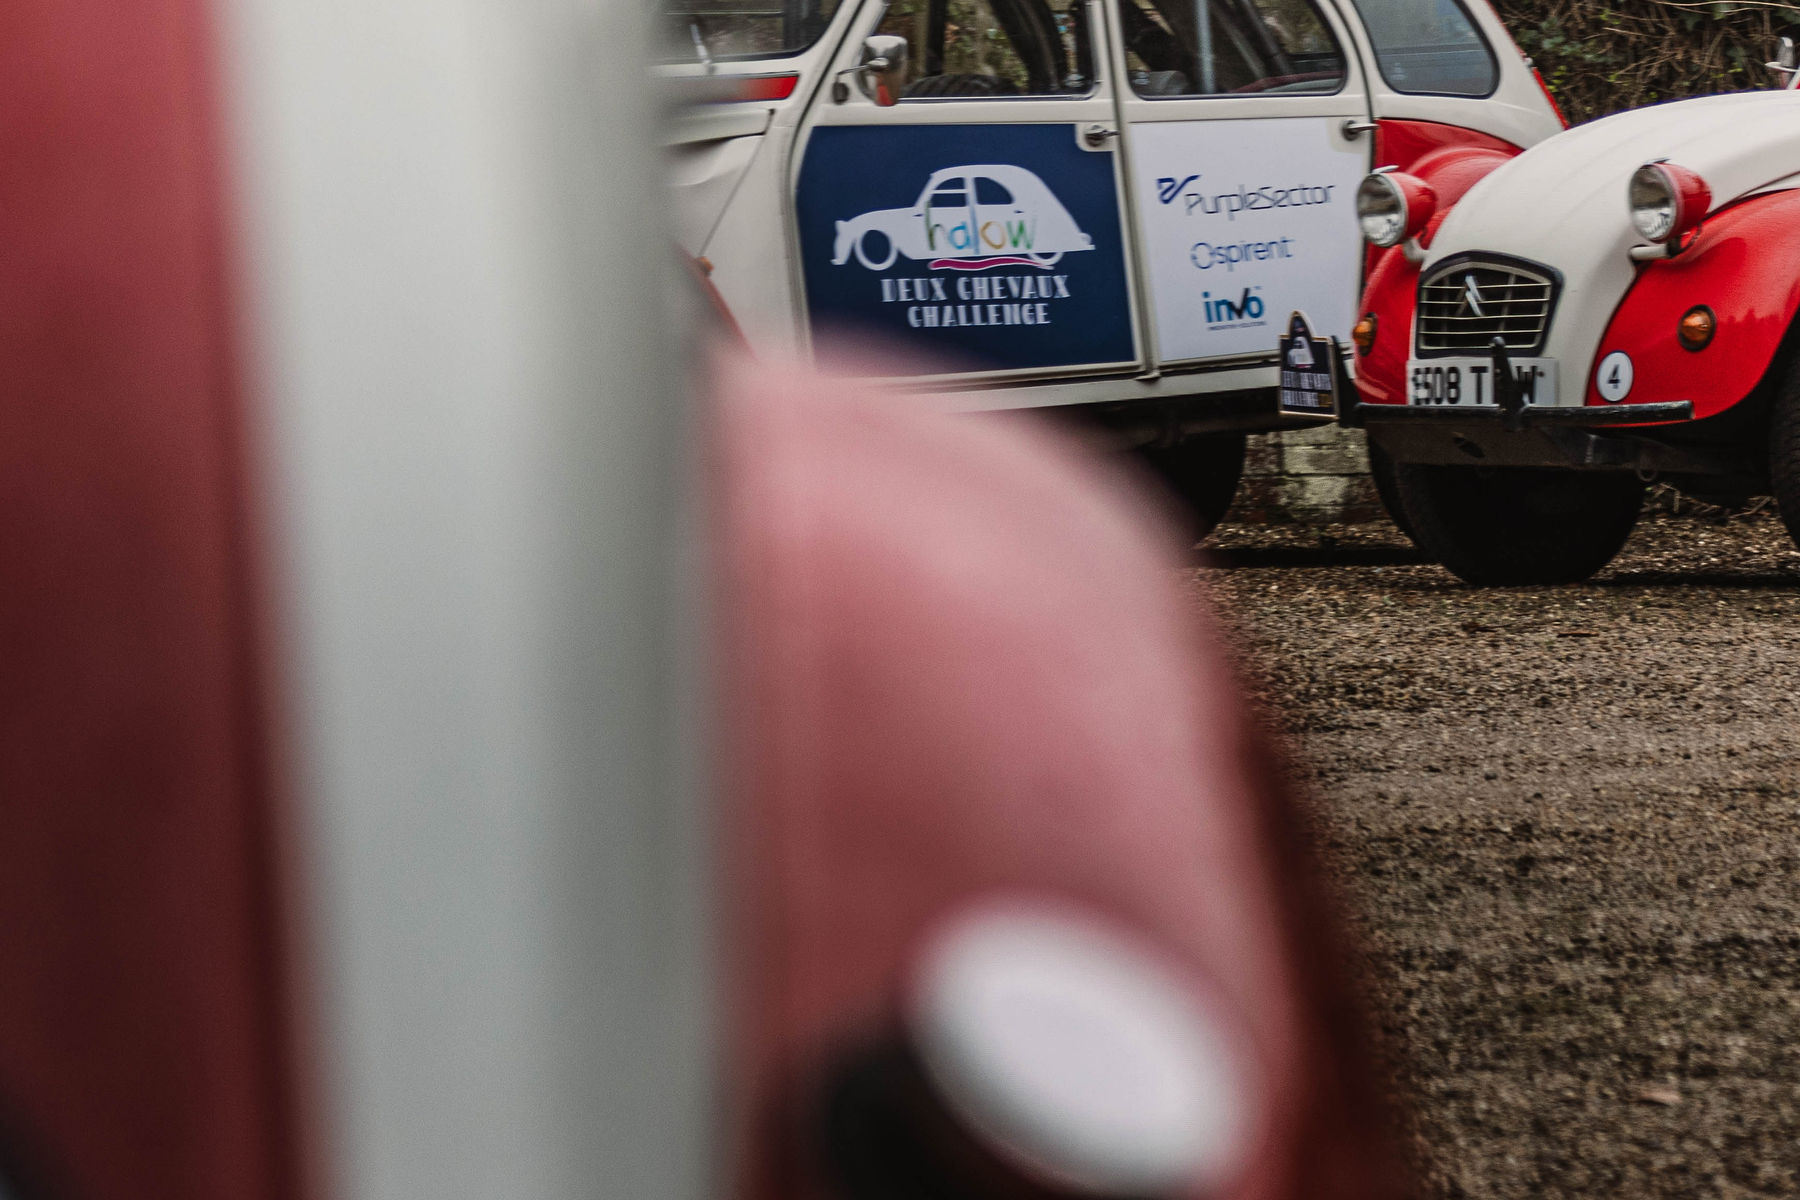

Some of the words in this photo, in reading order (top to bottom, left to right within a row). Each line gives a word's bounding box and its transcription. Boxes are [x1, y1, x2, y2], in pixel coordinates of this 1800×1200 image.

[1184, 184, 1336, 221] PurpleSector
[880, 277, 948, 302] DEUX
[957, 275, 1071, 300] CHEVAUX
[907, 303, 1051, 327] CHALLENGE
[1607, 364, 1621, 389] 4
